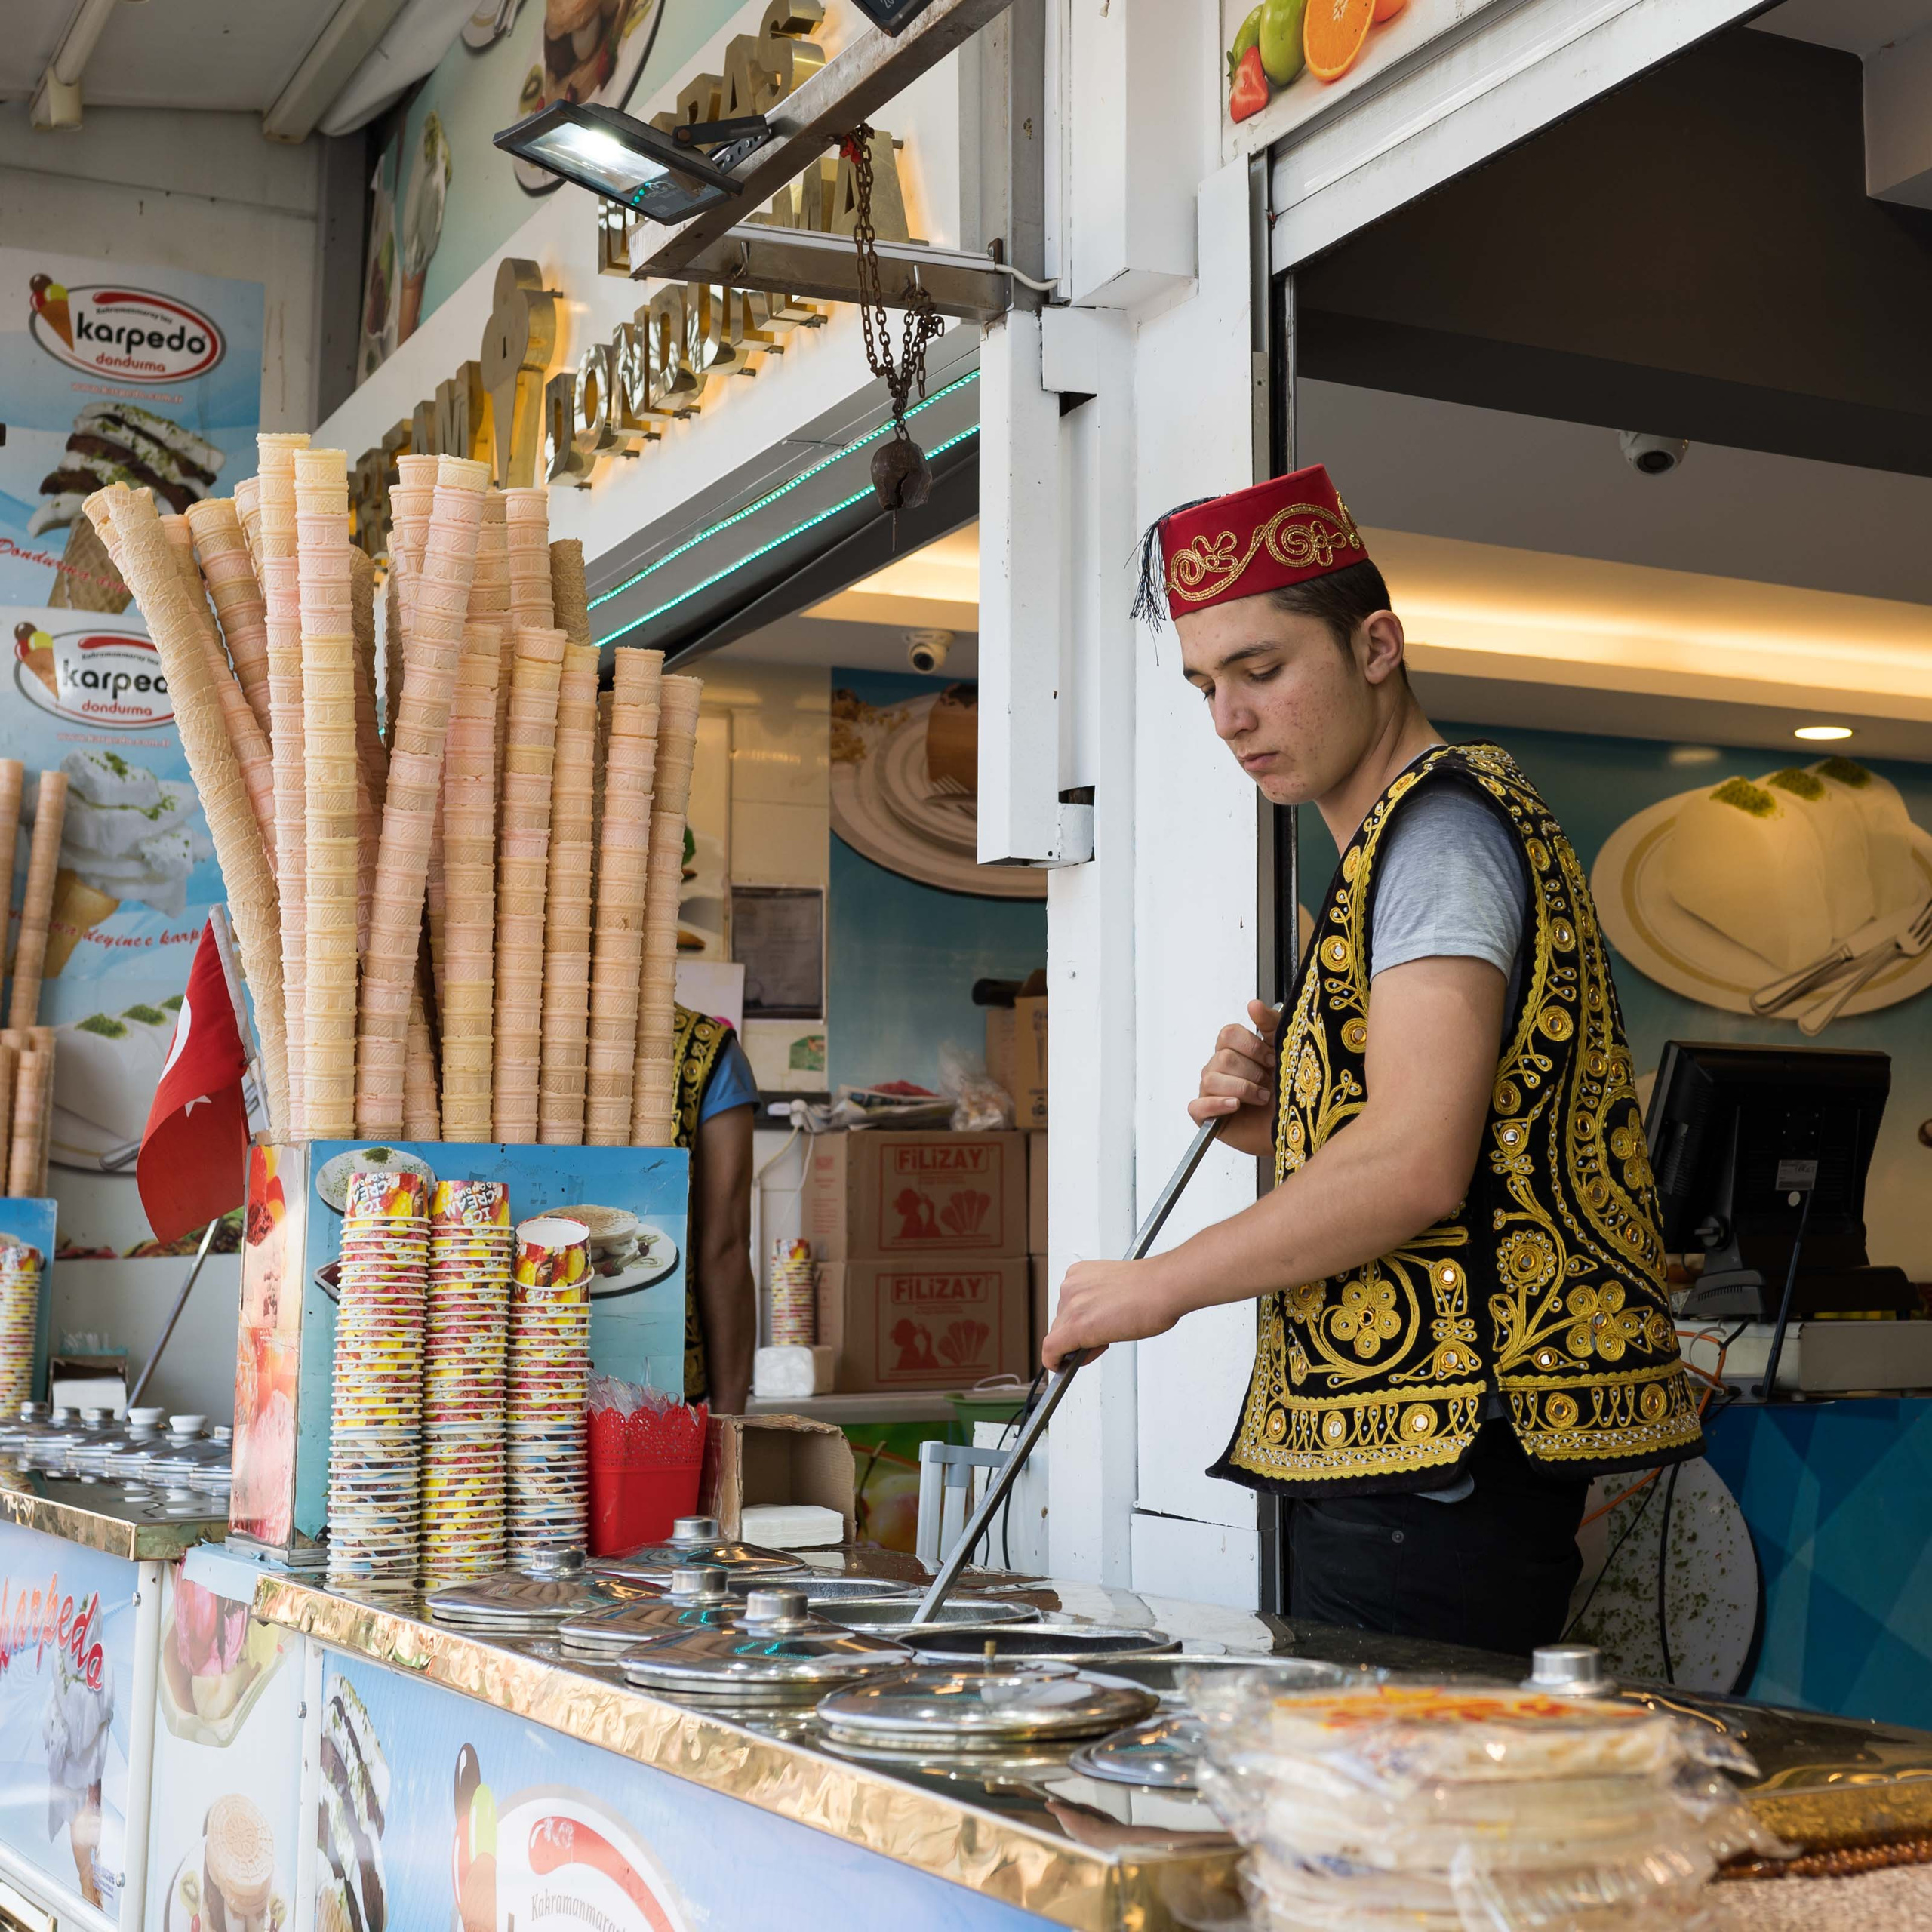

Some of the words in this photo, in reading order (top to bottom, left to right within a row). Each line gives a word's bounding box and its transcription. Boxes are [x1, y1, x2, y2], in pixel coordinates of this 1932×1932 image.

[77, 312, 206, 355] karpedo
[95, 352, 166, 373] dondurma
[81, 699, 153, 716] dondurma
[82, 927, 154, 949] deyince
[158, 928, 205, 946] karp
[443, 1189, 496, 1220] CREAM
[463, 1207, 493, 1226] ICE
